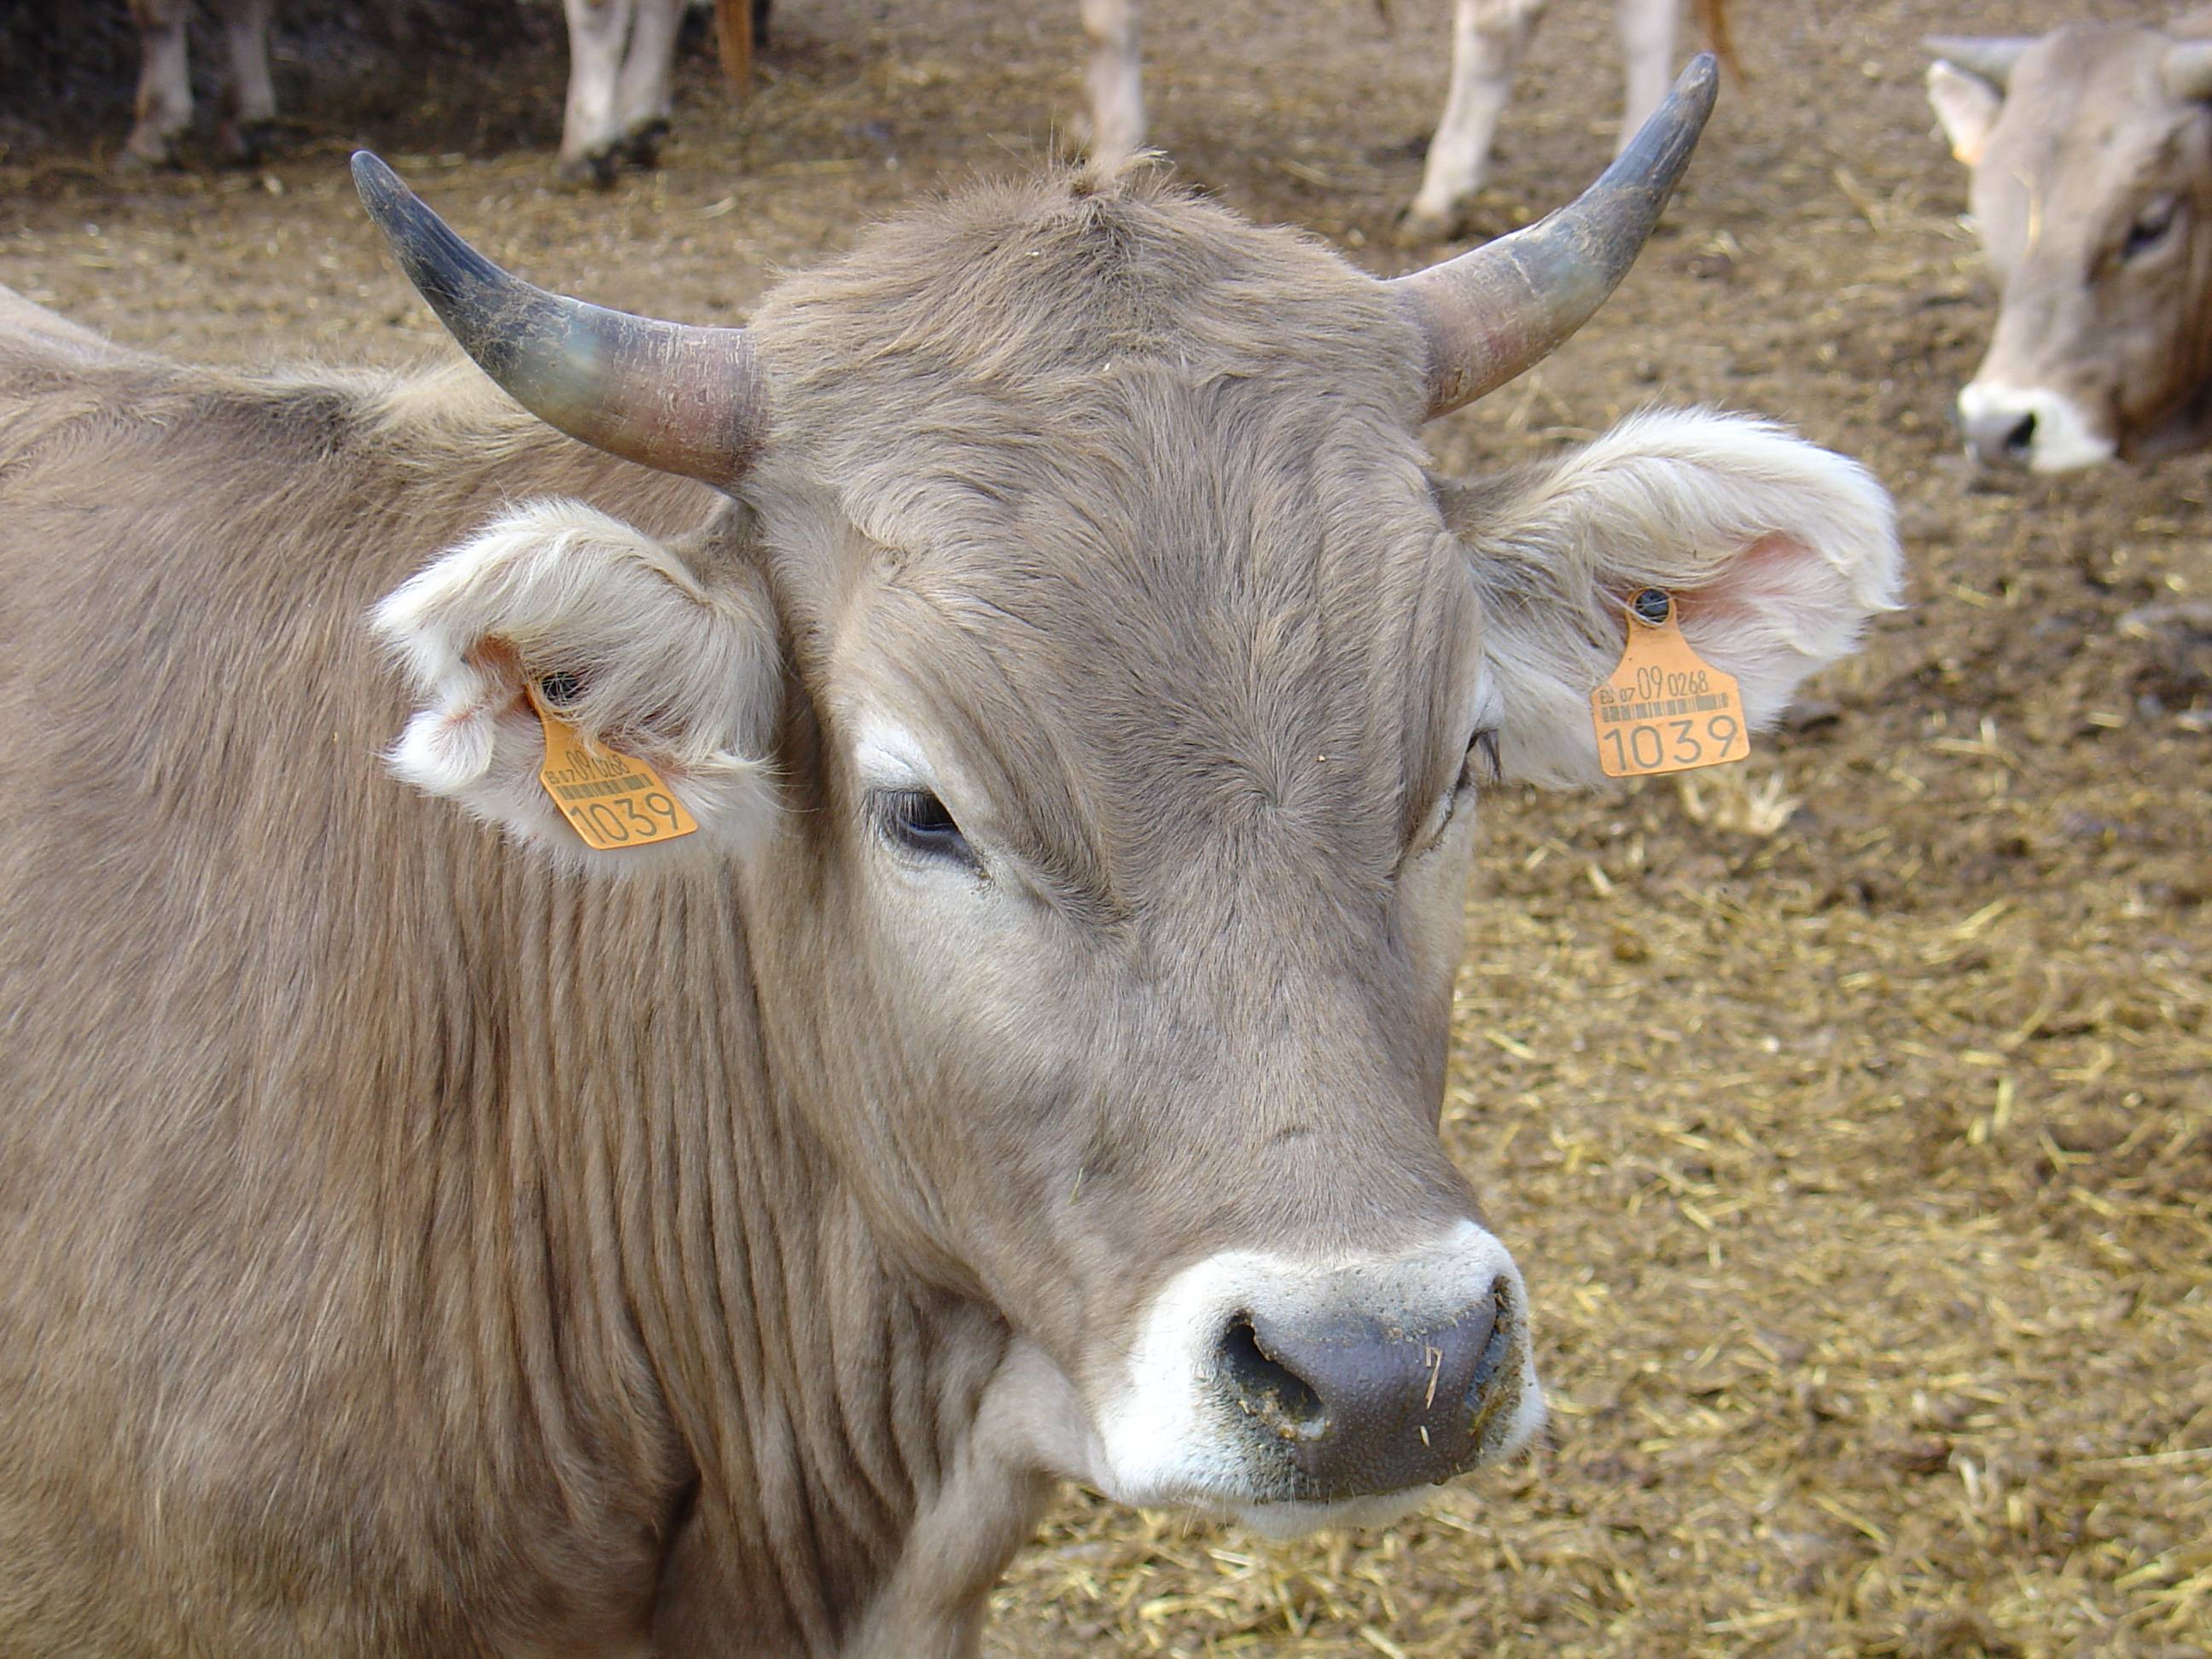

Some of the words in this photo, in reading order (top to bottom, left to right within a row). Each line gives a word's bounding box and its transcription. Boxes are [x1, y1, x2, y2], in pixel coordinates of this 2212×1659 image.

[1638, 666, 1662, 700] 09
[1668, 670, 1708, 697] 0268
[1604, 715, 1738, 771] 1039
[570, 793, 678, 843] 1039
